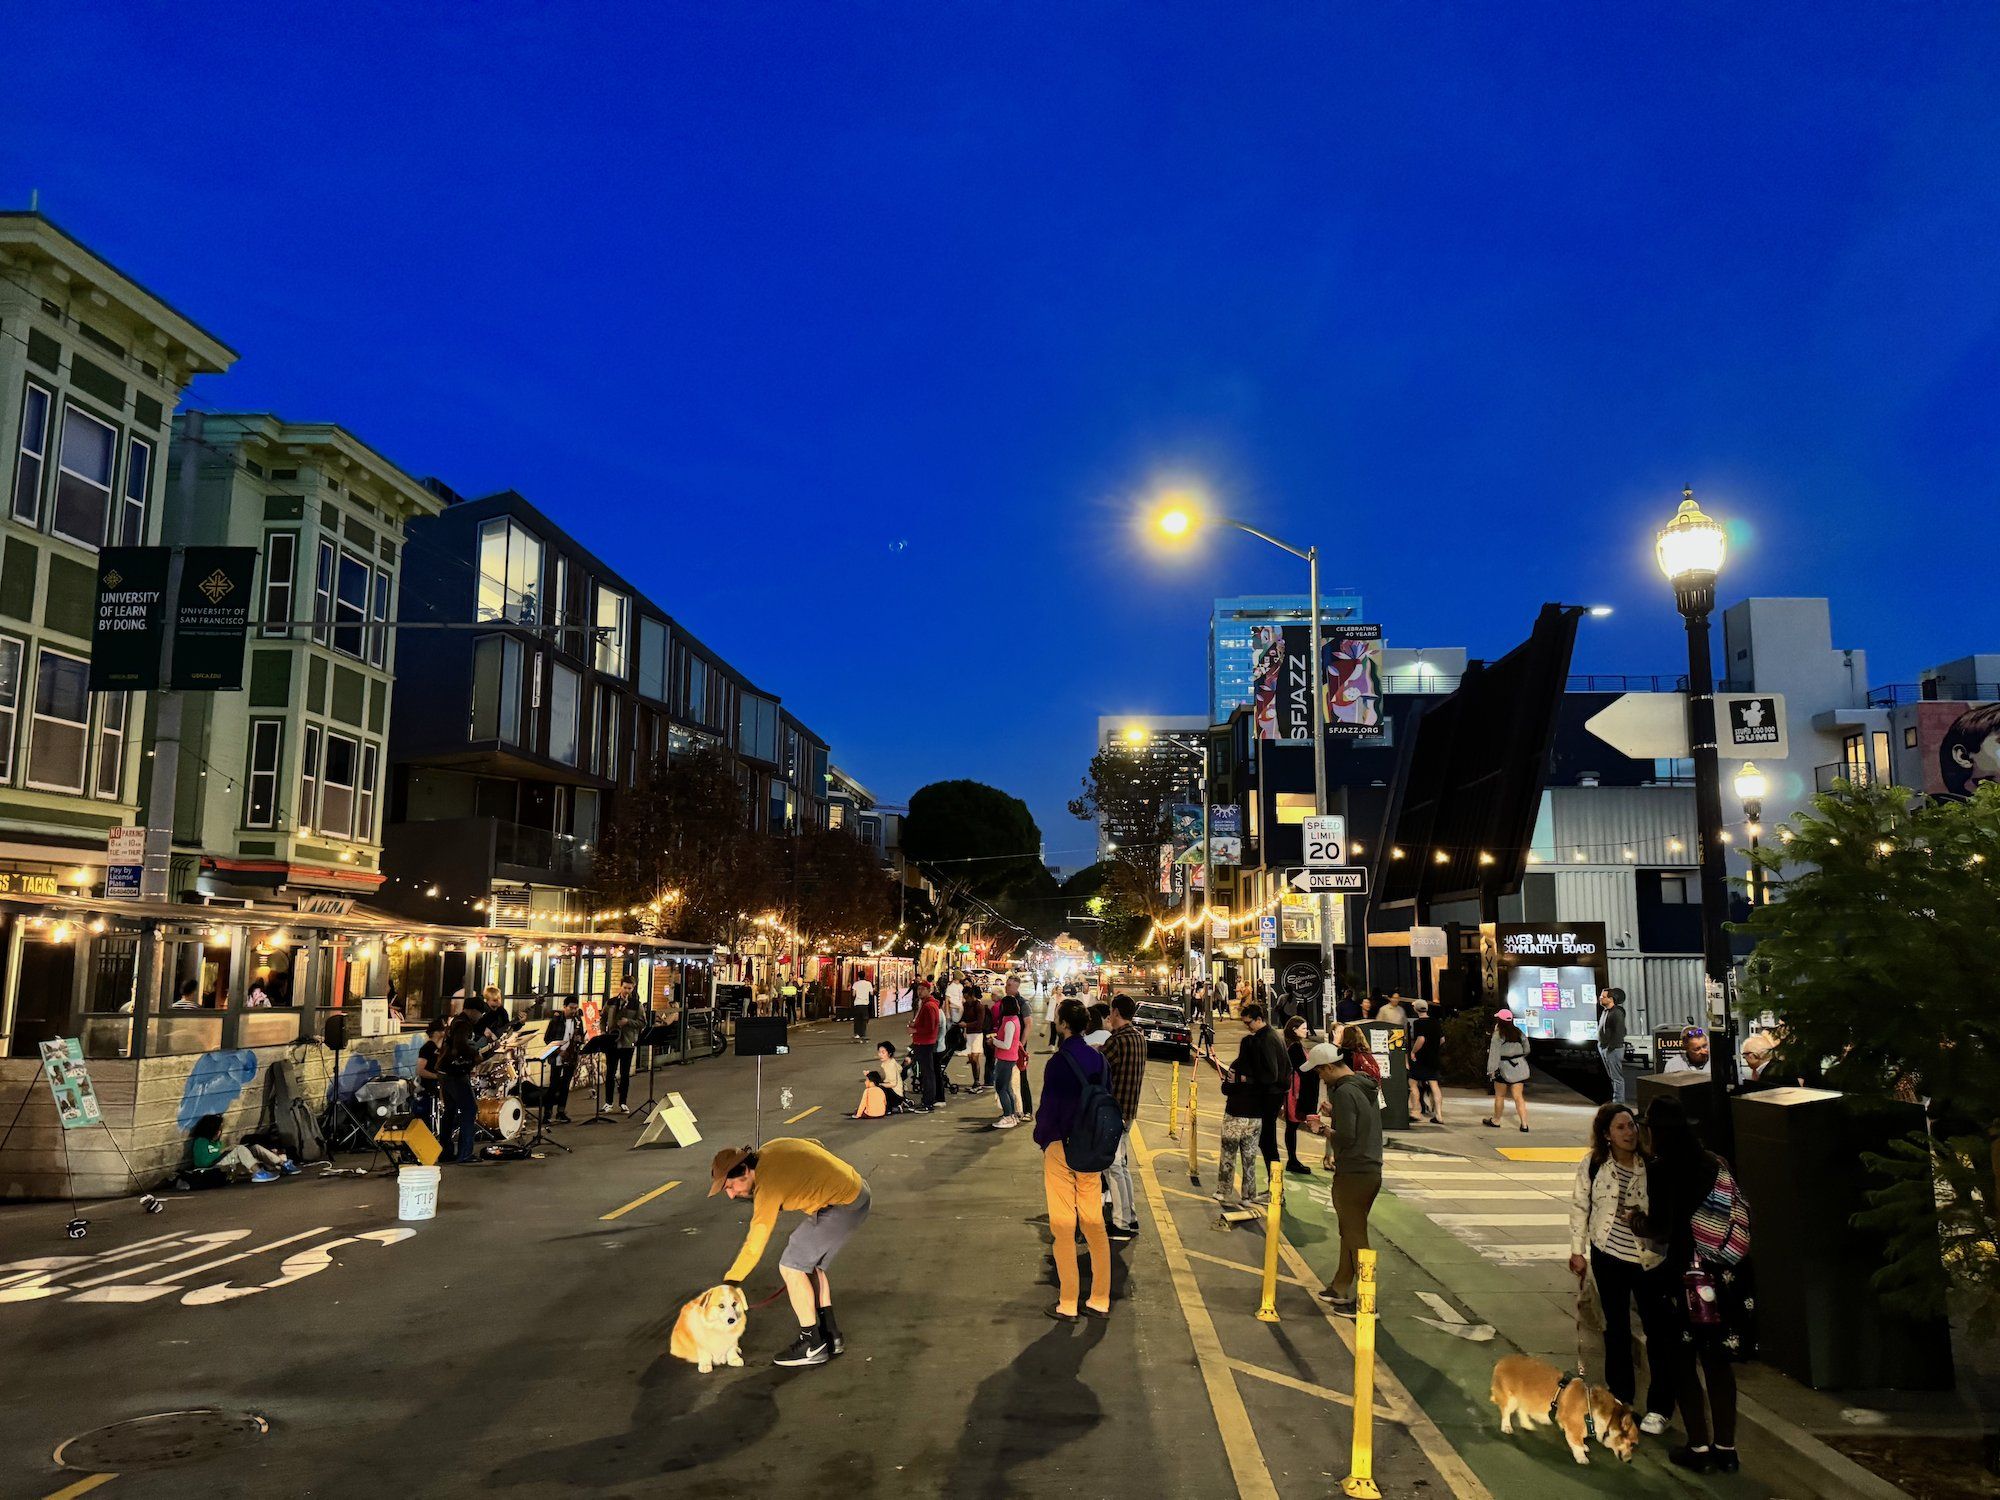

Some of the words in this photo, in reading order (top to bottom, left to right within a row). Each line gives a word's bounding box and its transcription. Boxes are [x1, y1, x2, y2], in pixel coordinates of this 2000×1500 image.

[101, 592, 160, 603] UNIVERSITY
[100, 606, 113, 617] OF
[115, 606, 147, 617] LEARN
[181, 607, 231, 615] UNIVERSITY
[234, 608, 246, 616] OF
[99, 619, 113, 630] BY
[114, 619, 147, 630] DOING.
[179, 616, 197, 624] SAN
[199, 617, 244, 625] FRANCISCO
[1289, 654, 1308, 739] SFJAZZ
[1735, 733, 1776, 741] DUMB
[1307, 821, 1341, 830] SPEED
[110, 827, 121, 839] NO
[1311, 832, 1336, 840] LIMIT
[1309, 842, 1340, 860] 20
[123, 867, 132, 875] by
[1175, 863, 1183, 894] SFJAZ
[1309, 875, 1332, 886] ONE
[1335, 875, 1357, 886] WAY
[22, 876, 55, 895] TACKS
[1503, 934, 1534, 944] HAYES
[1537, 933, 1577, 945] VALLEY
[1504, 944, 1557, 954] COMMUNITY
[1562, 944, 1596, 954] BOARD
[415, 1192, 434, 1205] TIP
